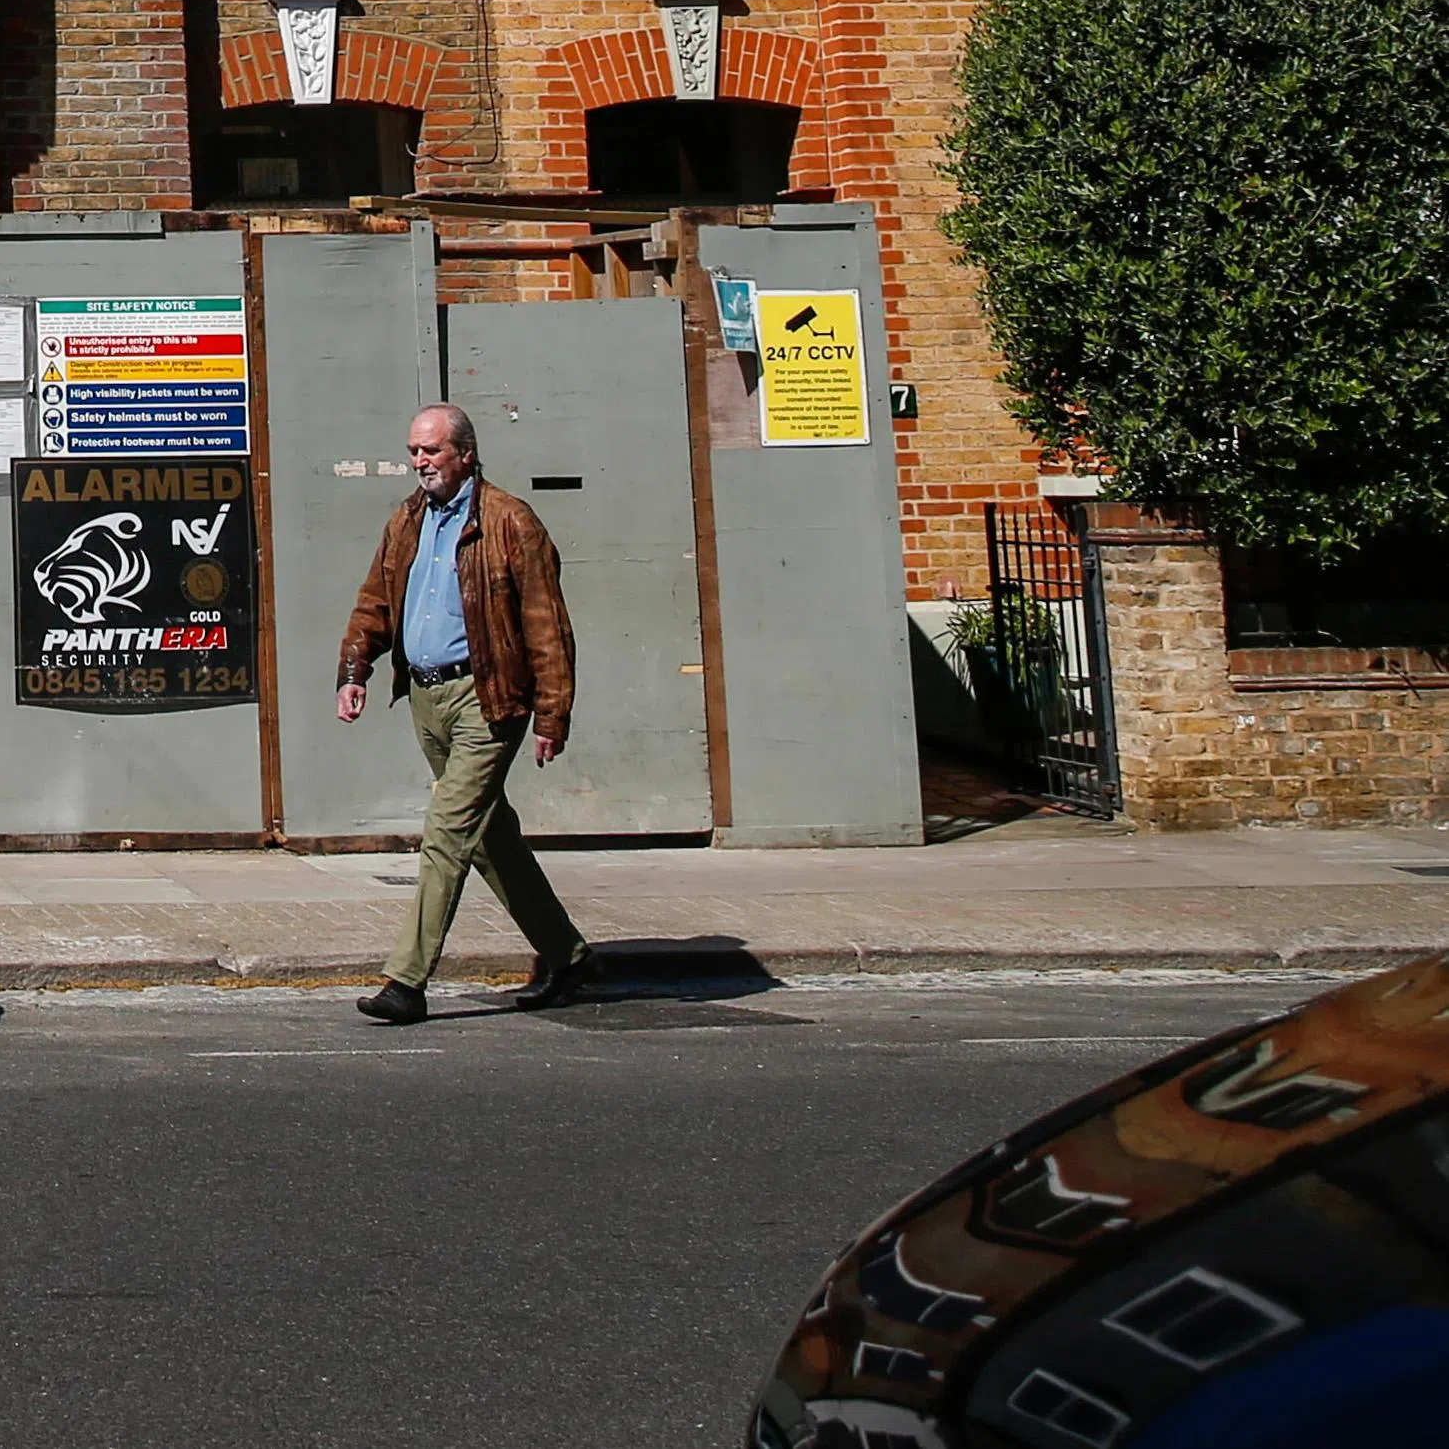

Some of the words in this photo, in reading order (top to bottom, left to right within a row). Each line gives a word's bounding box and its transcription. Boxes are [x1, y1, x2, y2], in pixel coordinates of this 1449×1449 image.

[86, 302, 111, 312] SITE
[112, 301, 154, 311] SAFETY
[155, 300, 197, 311] NOTICE
[69, 337, 127, 346] Unauthorised
[128, 338, 151, 347] entry
[152, 337, 162, 345] to
[163, 336, 180, 344] this
[181, 336, 198, 344] site
[79, 346, 110, 355] strictly
[110, 345, 155, 355] prohibited
[766, 346, 802, 362] 24/7
[807, 345, 855, 360] CCTV
[70, 389, 93, 400] High
[95, 387, 136, 400] visibility
[137, 387, 173, 399] jackets
[174, 388, 199, 397] must
[200, 387, 213, 396] be
[214, 388, 239, 397] worn
[891, 386, 909, 411] 7
[70, 412, 106, 424] Safety
[108, 411, 152, 422] helmets
[154, 412, 183, 421] must
[184, 411, 198, 421] be
[200, 412, 228, 421] worn
[71, 437, 121, 447] Protective
[122, 437, 166, 447] footwear
[167, 437, 192, 446] must
[193, 436, 205, 445] be
[206, 437, 232, 446] worn
[21, 467, 243, 502] ALARMED
[189, 610, 222, 622] GOLD
[41, 627, 228, 651] PANTHERA
[41, 654, 144, 666] SECURITY
[25, 668, 101, 693] 0845
[113, 667, 166, 693] 165
[178, 666, 249, 692] 1234
